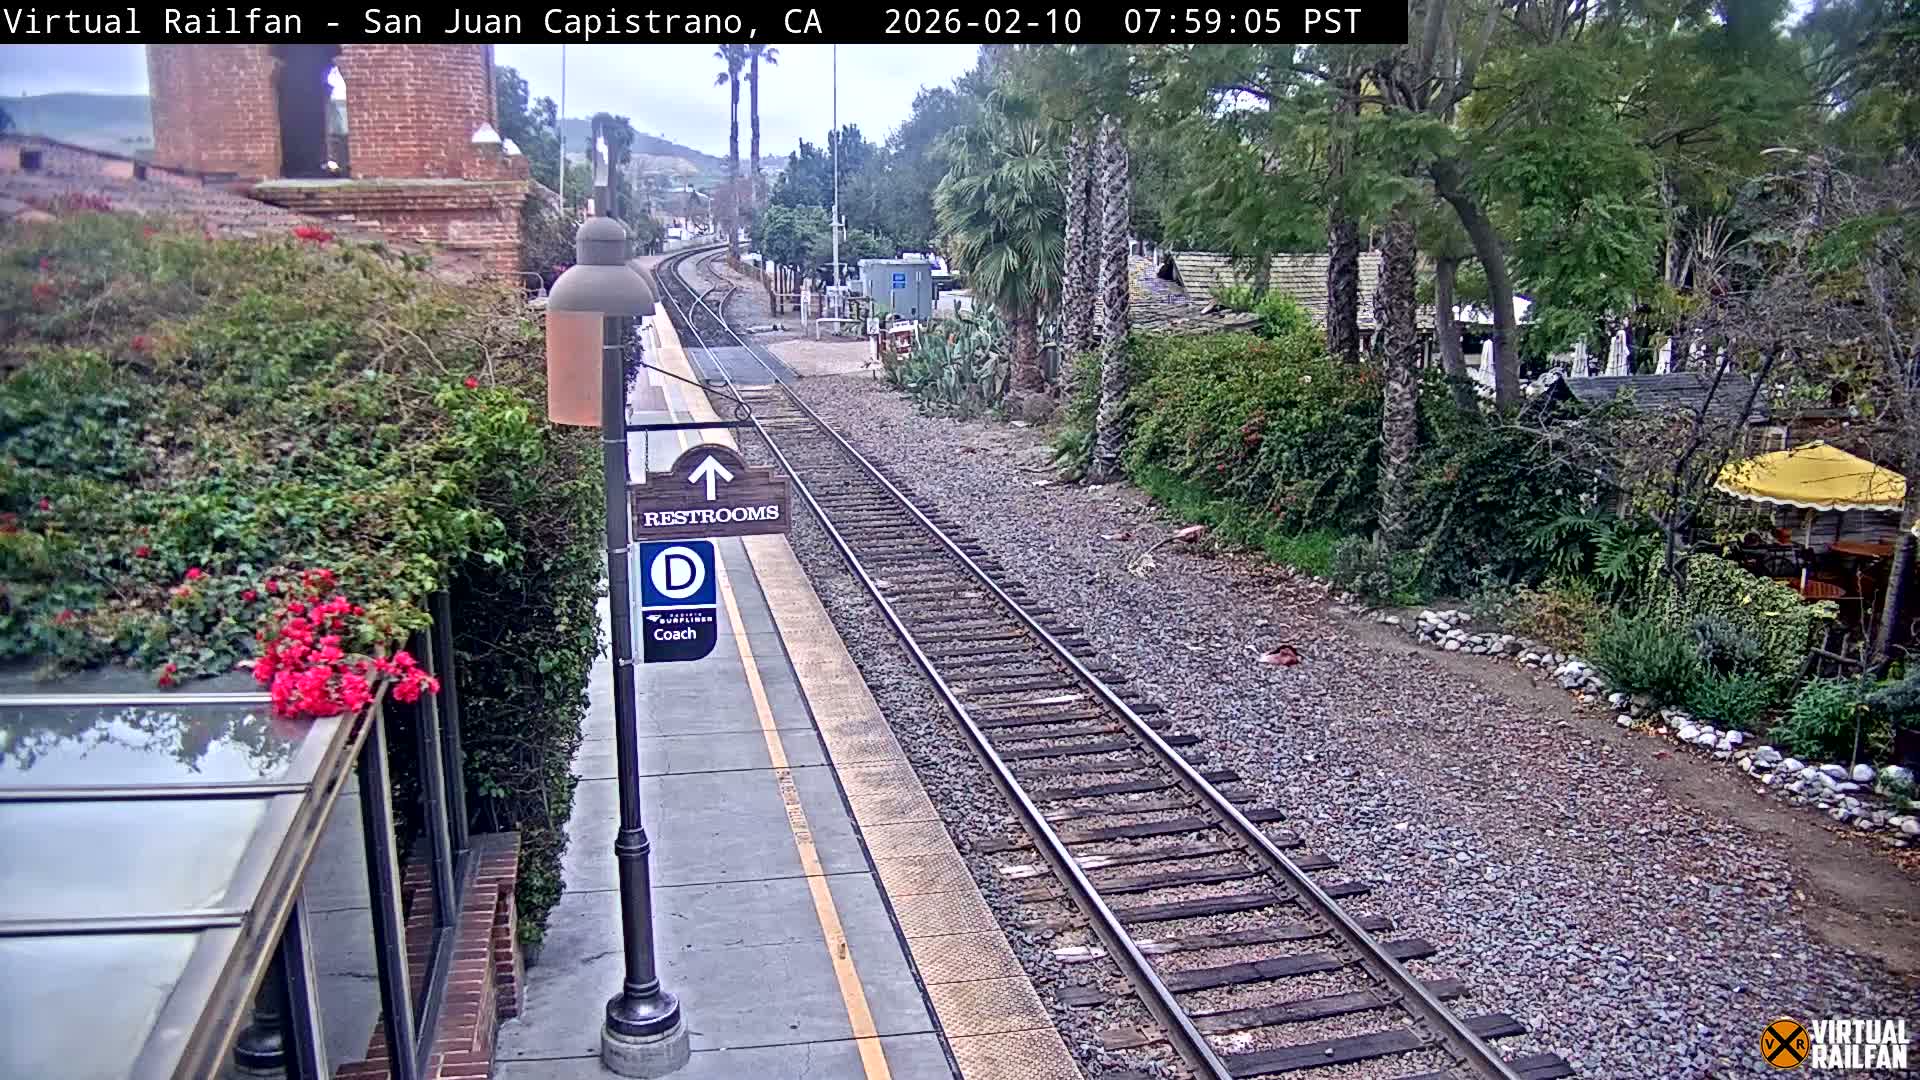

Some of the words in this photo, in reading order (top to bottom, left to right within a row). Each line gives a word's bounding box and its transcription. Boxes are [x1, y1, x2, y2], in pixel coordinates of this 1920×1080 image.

[643, 505, 779, 527] RESTROOMS
[665, 554, 697, 591] D
[653, 626, 697, 641] Coach
